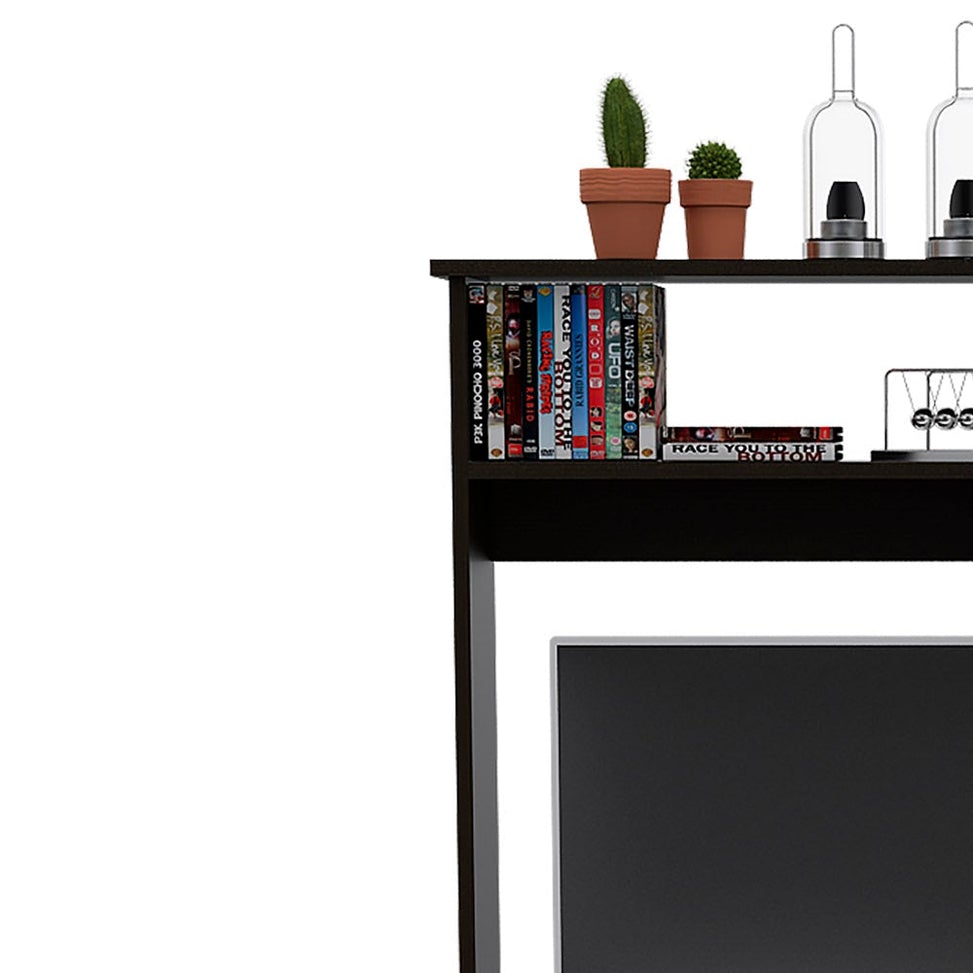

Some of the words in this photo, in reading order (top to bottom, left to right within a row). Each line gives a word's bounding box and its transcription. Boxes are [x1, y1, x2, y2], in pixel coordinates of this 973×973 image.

[562, 295, 572, 346] RACE
[473, 340, 482, 368] 3000
[609, 342, 620, 379] UFO
[624, 324, 634, 367] WAIST
[562, 350, 573, 388] YOU
[473, 372, 483, 420] PINOCHO
[555, 361, 564, 446] BOTTOM
[563, 390, 573, 410] TO
[626, 370, 634, 407] DEEP
[563, 414, 573, 450] THE
[672, 445, 718, 453] RACE
[725, 445, 757, 453] YOU
[765, 445, 788, 453] TO
[794, 445, 826, 453] THE
[737, 452, 822, 461] BOTTOM
